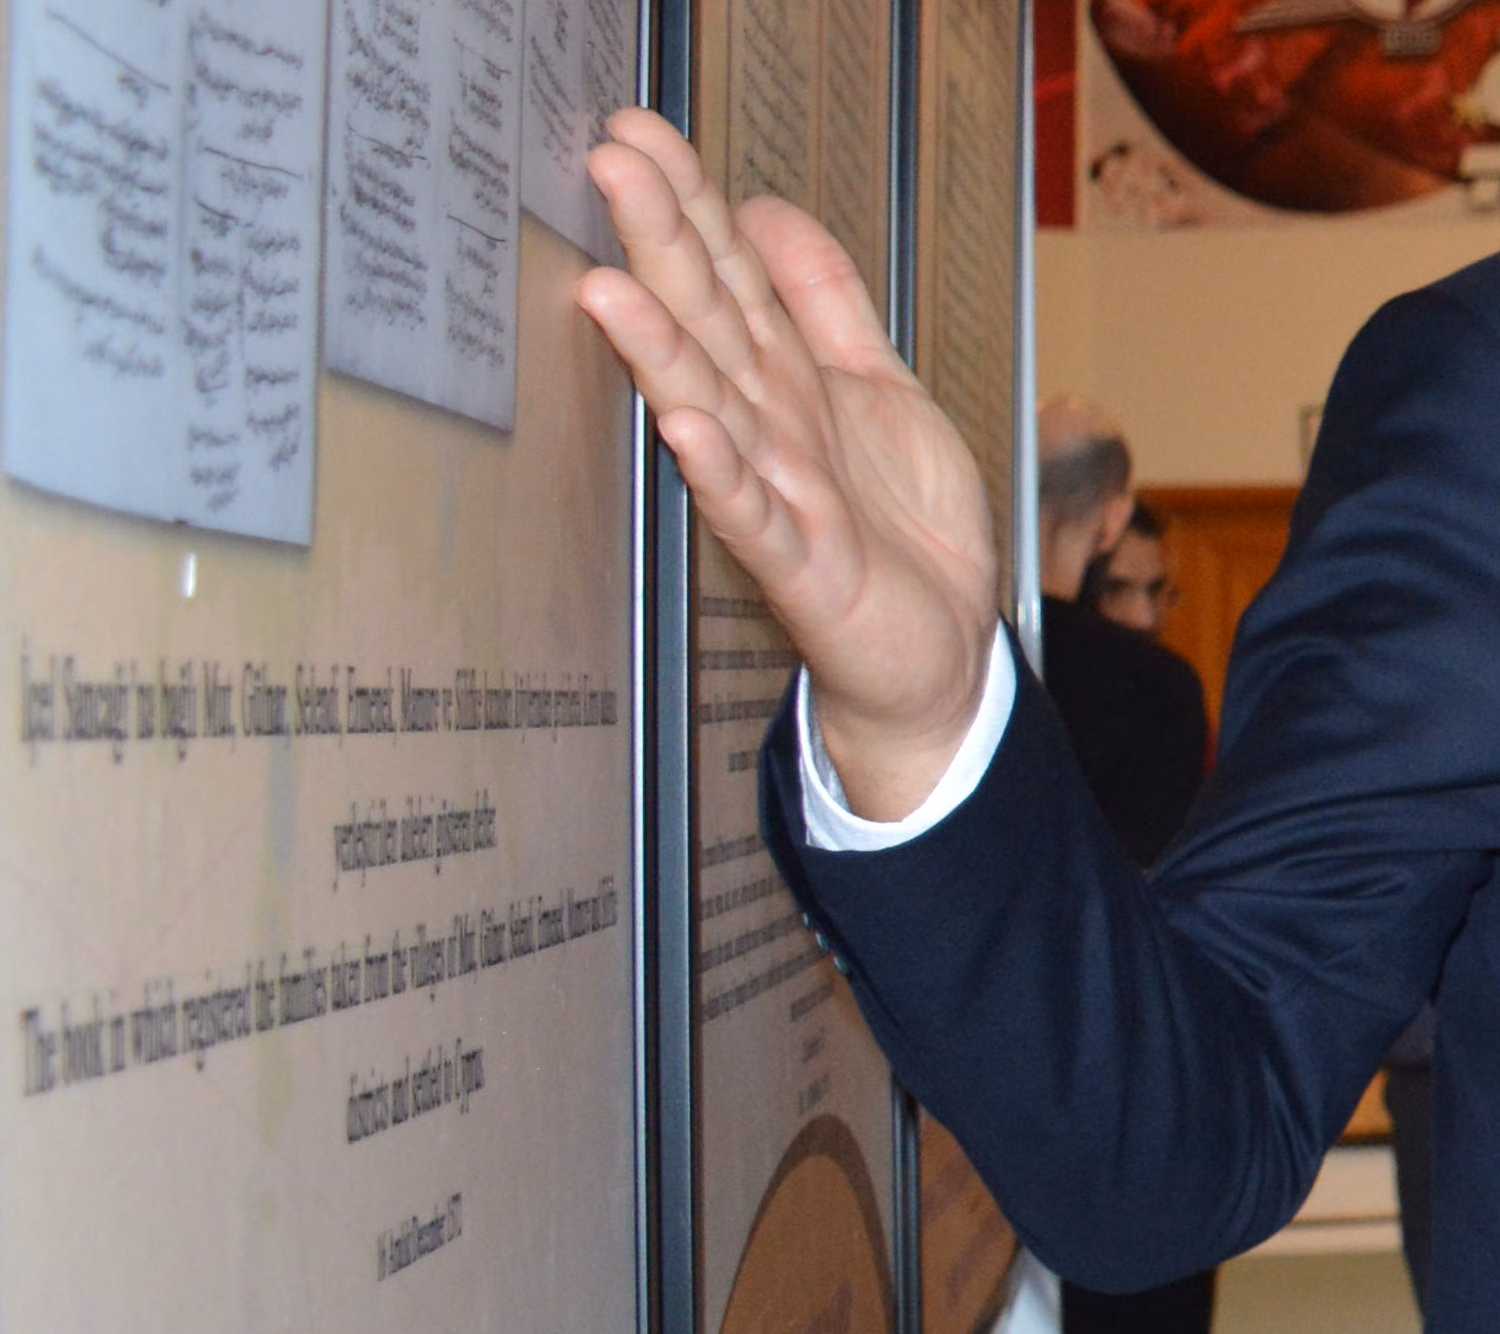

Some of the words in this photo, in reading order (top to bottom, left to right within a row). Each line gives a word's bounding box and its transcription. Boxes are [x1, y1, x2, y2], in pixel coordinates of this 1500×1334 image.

[20, 1007, 56, 1097] The
[61, 995, 104, 1085] book
[129, 978, 177, 1065] which
[182, 960, 251, 1072] registered
[255, 958, 275, 1033] the
[279, 945, 327, 1025] families
[331, 941, 361, 1010] taken
[364, 933, 389, 1003] from
[392, 927, 408, 995] the
[410, 923, 445, 1003] villages
[347, 1069, 389, 1145] districts
[392, 1055, 409, 1126] and
[411, 1045, 443, 1119] settled
[454, 1037, 486, 1116] Cyprus
